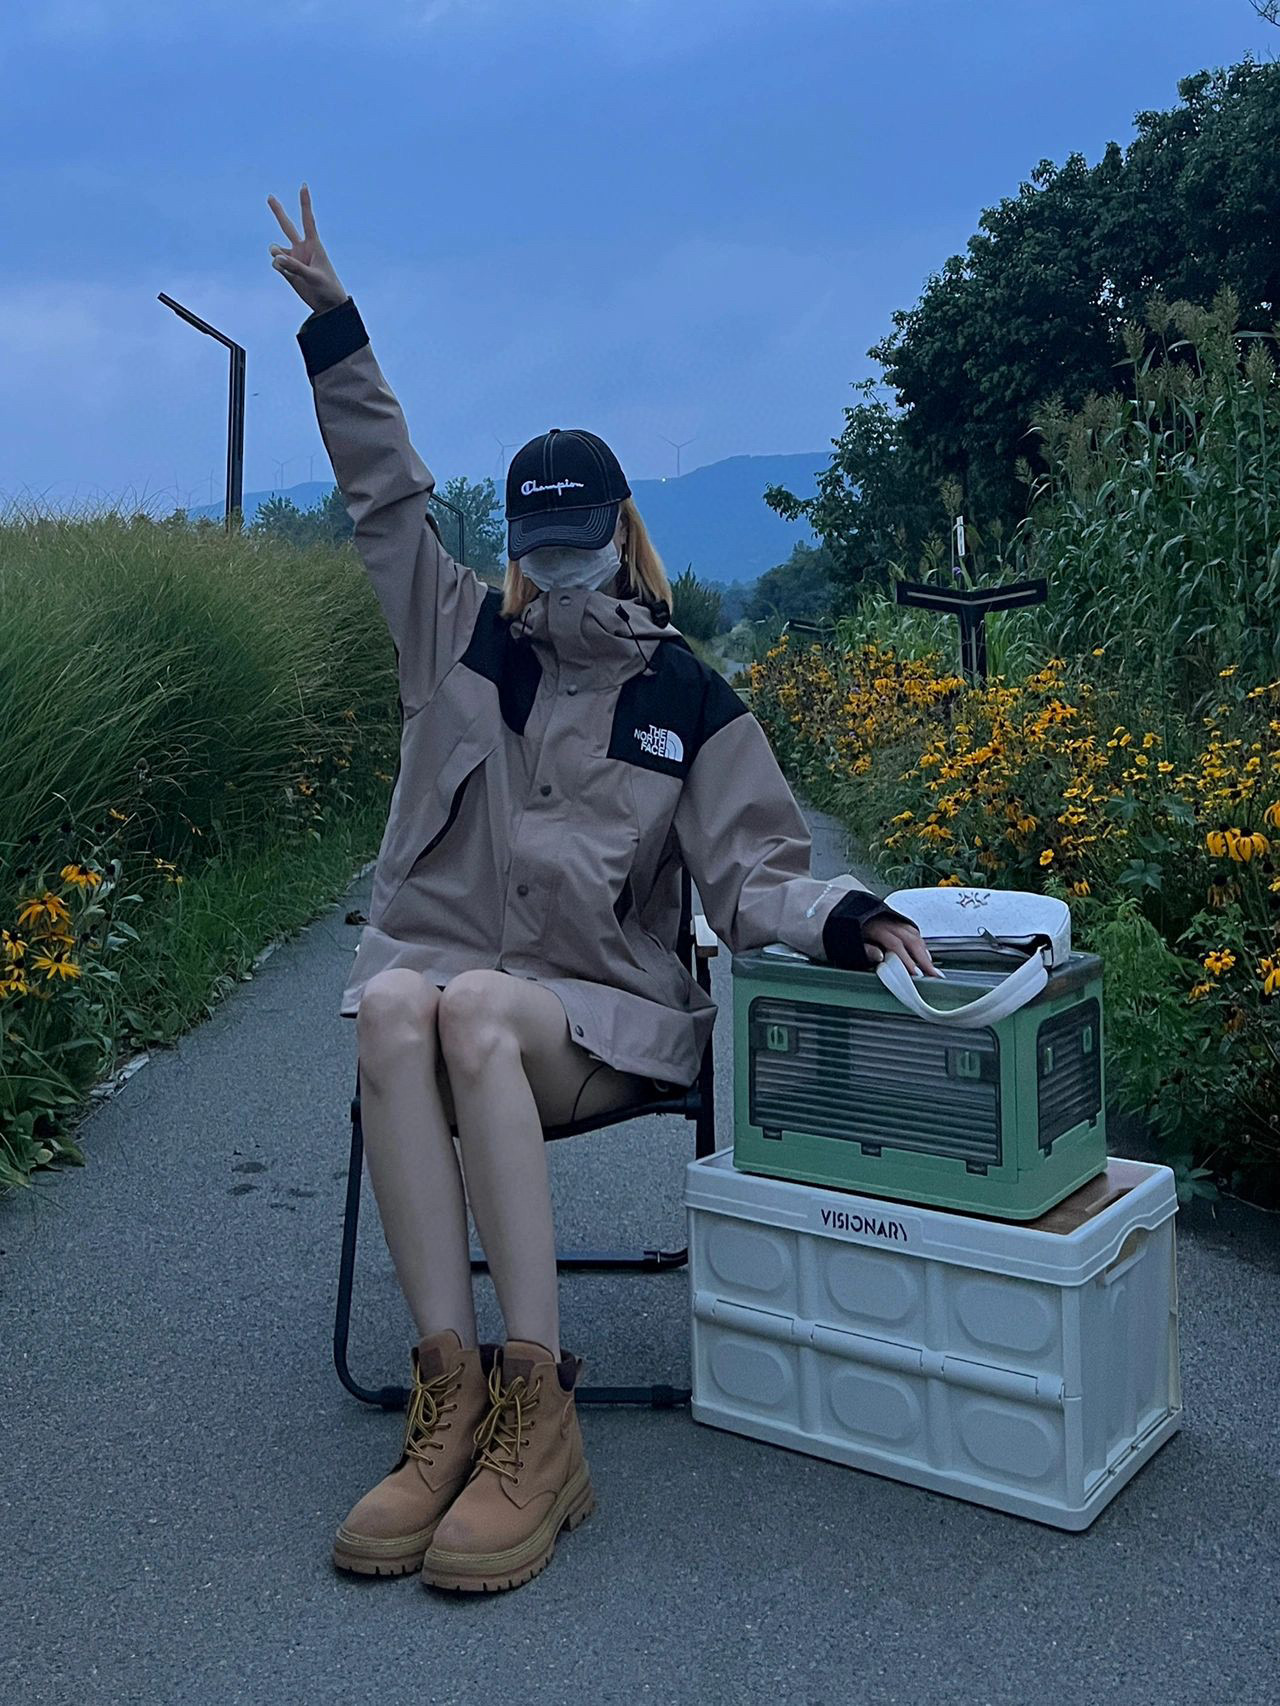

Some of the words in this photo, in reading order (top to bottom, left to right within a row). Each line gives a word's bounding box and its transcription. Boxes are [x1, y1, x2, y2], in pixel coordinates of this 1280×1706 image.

[521, 479, 584, 496] Champion
[633, 728, 667, 750] NORTH
[649, 724, 667, 739] THE
[640, 741, 665, 757] FACE
